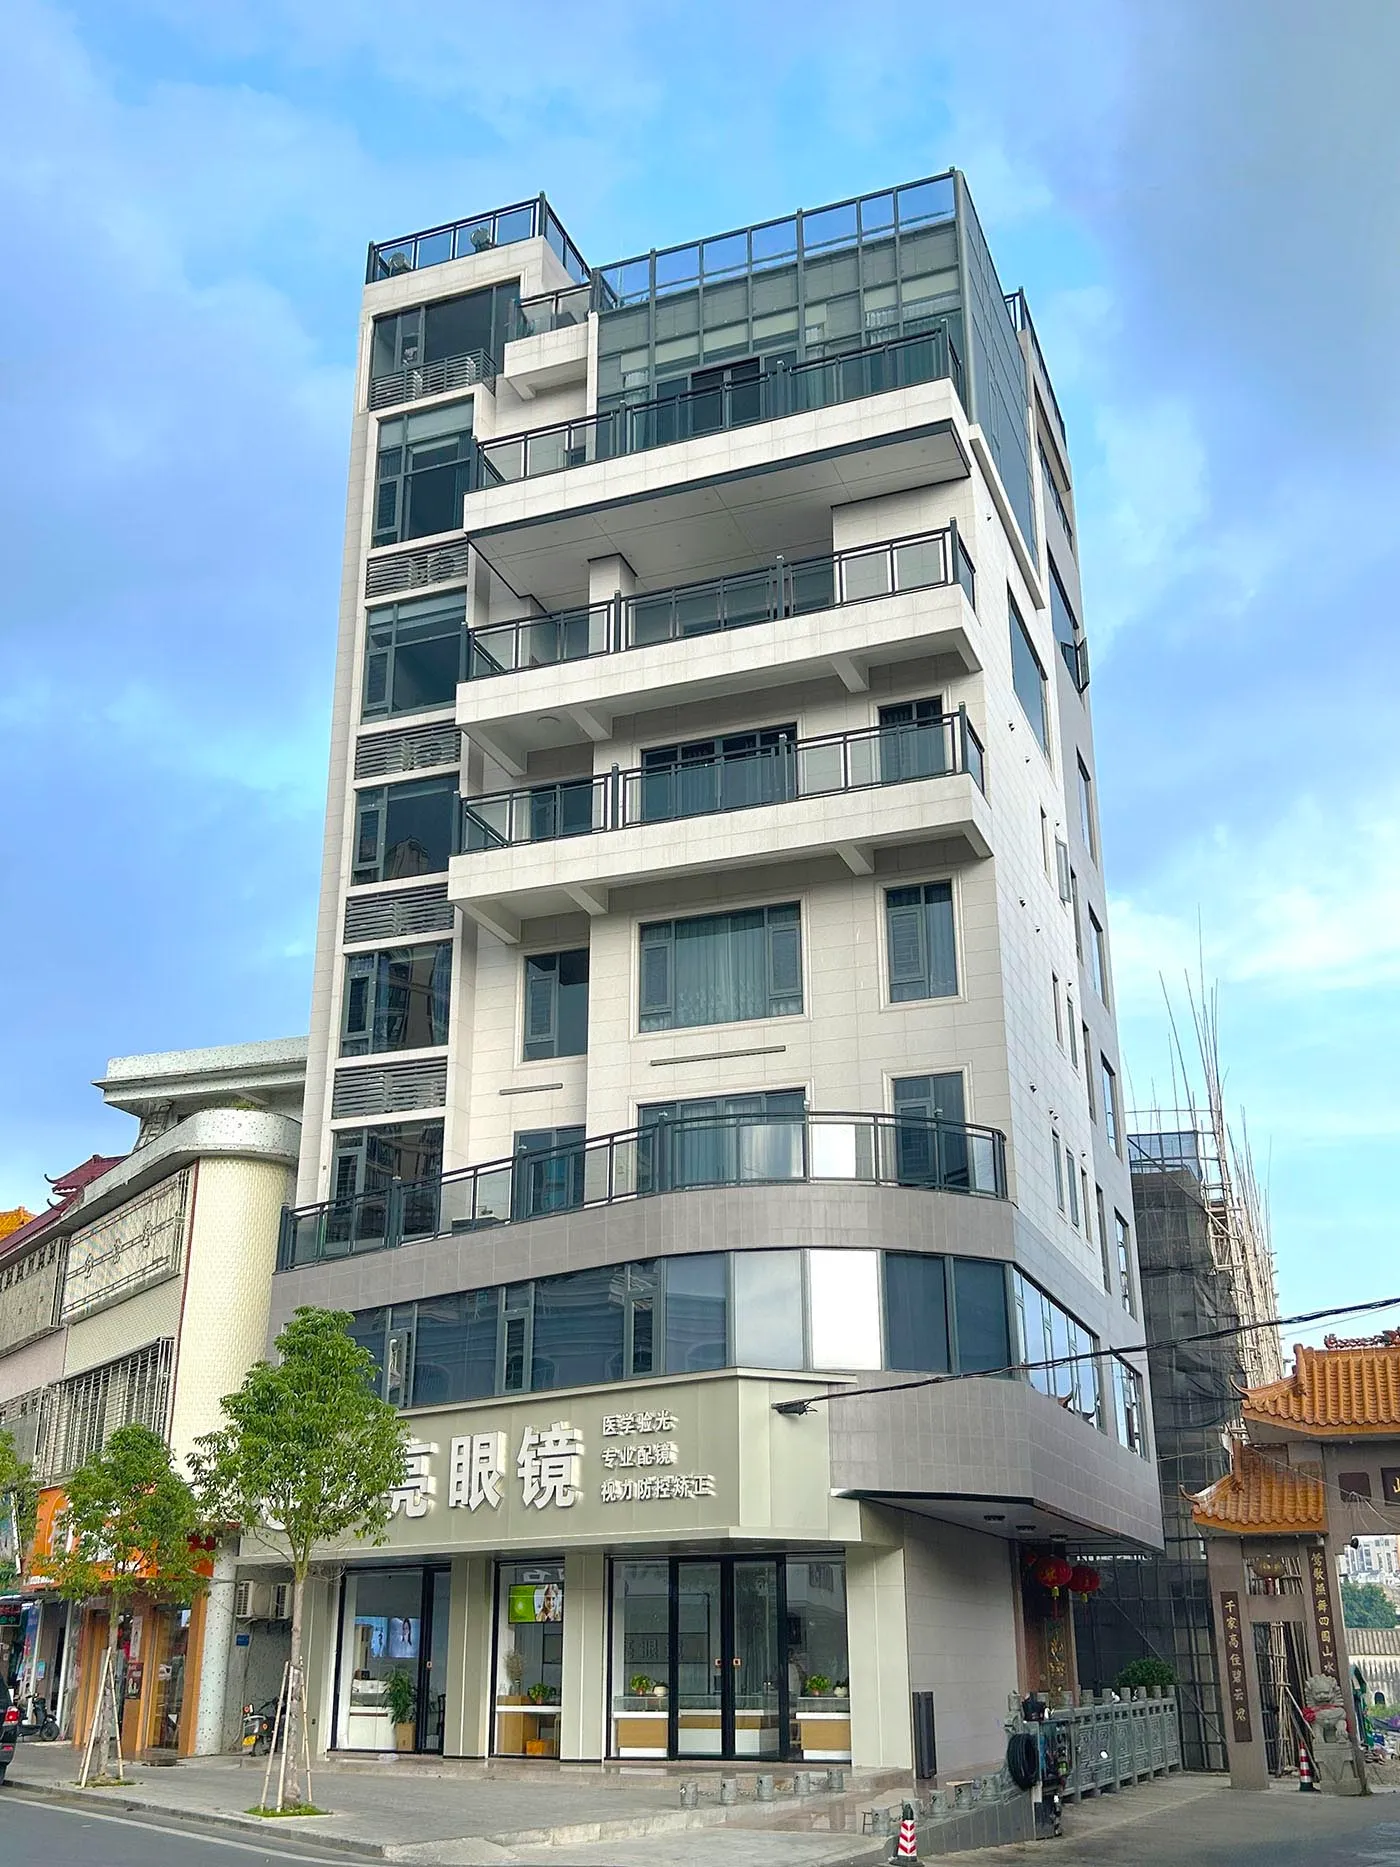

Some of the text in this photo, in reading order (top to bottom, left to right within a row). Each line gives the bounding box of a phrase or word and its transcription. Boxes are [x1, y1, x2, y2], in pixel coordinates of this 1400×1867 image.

[602, 1410, 679, 1436] 医学验光
[601, 1441, 679, 1469] 专业配镜
[600, 1473, 717, 1502] 视力防控矫正
